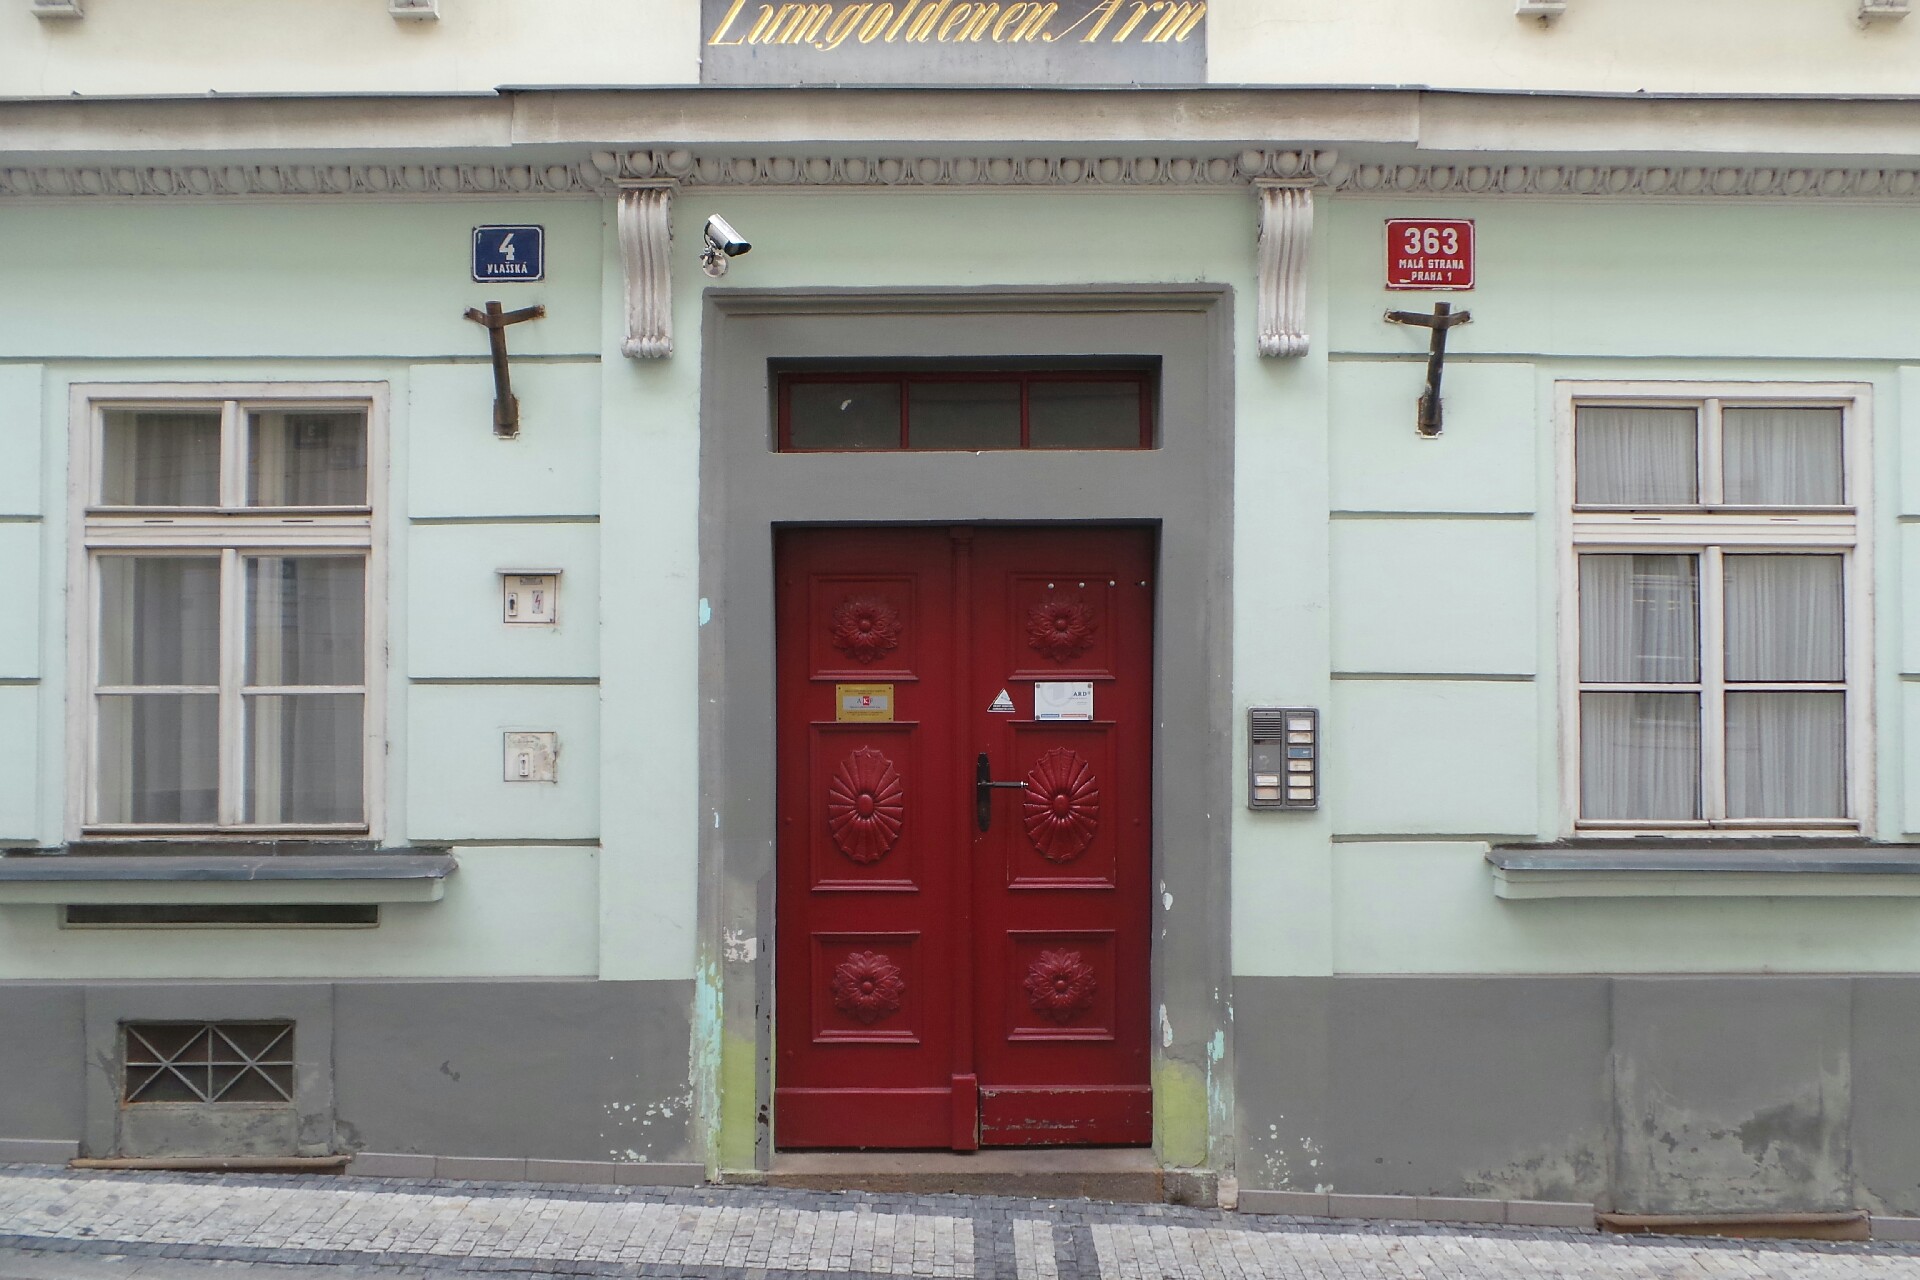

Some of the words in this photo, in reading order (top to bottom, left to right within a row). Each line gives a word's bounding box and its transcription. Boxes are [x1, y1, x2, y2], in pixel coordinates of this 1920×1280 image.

[815, 0, 1058, 52] goldenen
[1042, 0, 1207, 43] Arm
[498, 232, 515, 261] 4
[1404, 227, 1459, 255] 363
[487, 261, 528, 274] VLAŠSKÁ
[1398, 257, 1424, 269] MALÁ
[1428, 259, 1465, 270] STRANA
[1411, 271, 1443, 281] PRAHA
[1447, 271, 1454, 281] 1
